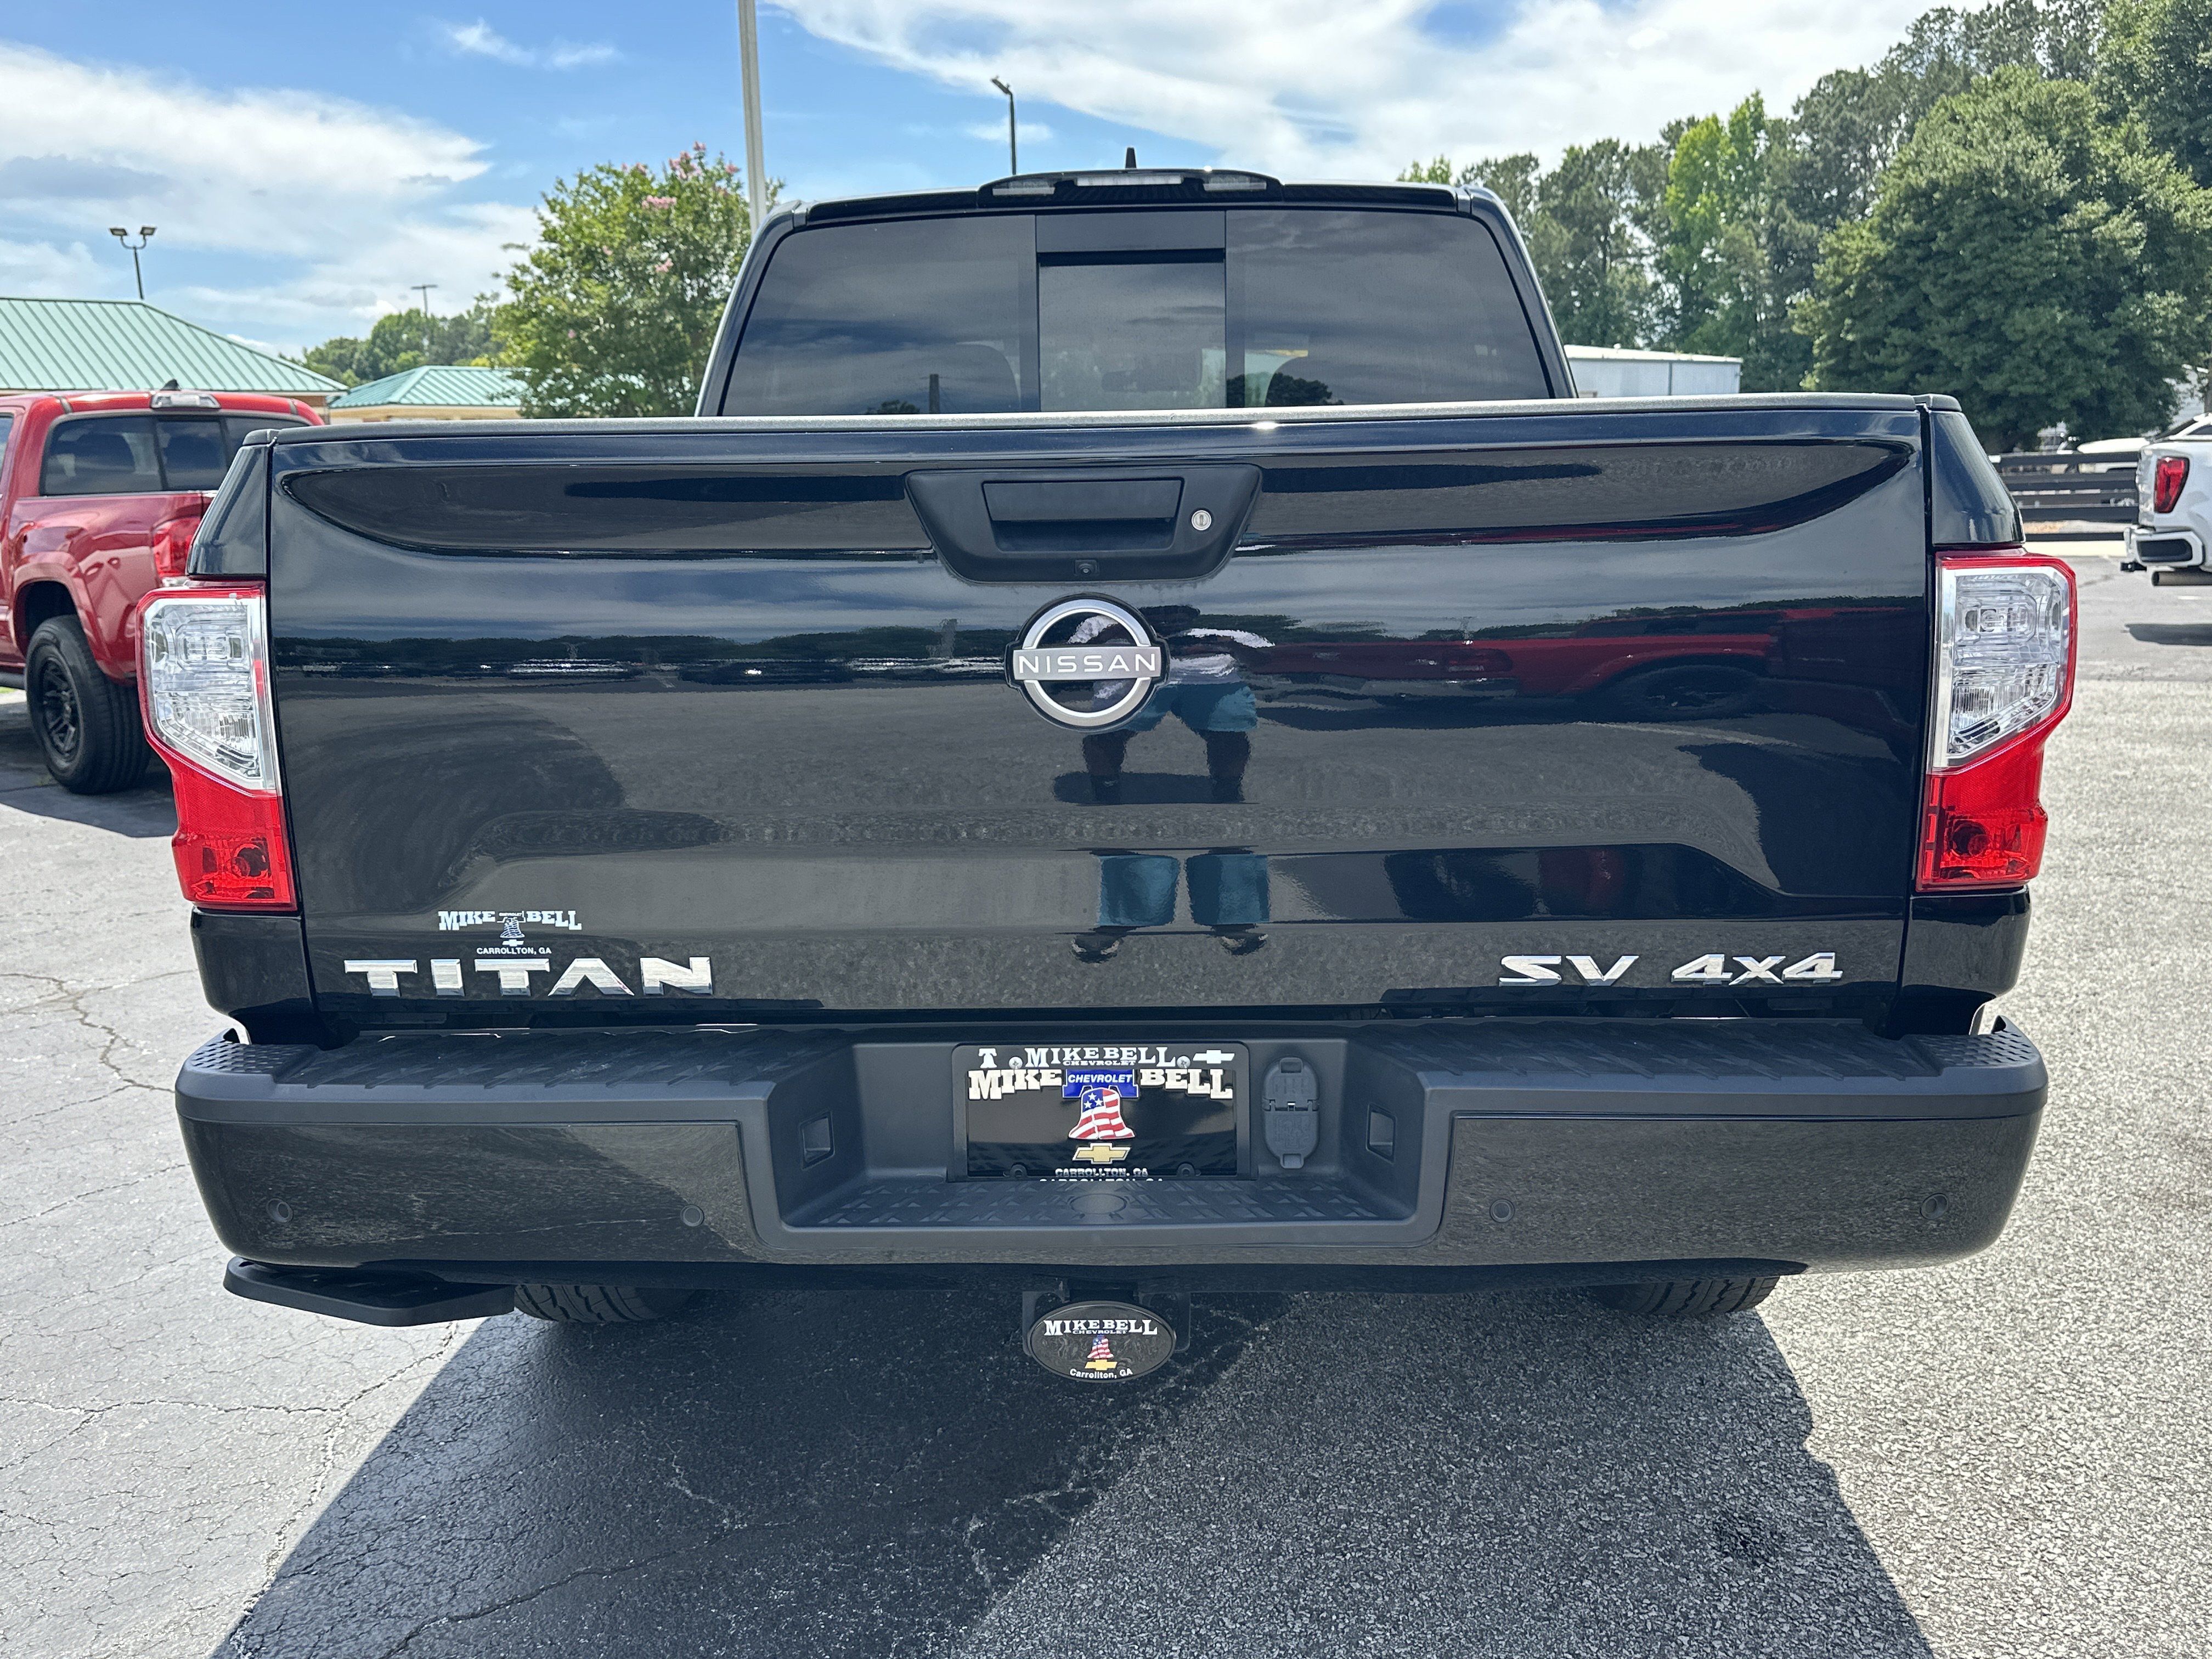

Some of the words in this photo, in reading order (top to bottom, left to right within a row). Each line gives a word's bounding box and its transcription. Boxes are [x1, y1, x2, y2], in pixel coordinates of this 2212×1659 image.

[1019, 653, 1156, 674] NISSAN
[437, 910, 496, 931] MIKE
[526, 910, 583, 930] BELL
[476, 947, 537, 955] CARROLLTON,
[344, 956, 713, 997] TITAN
[1498, 955, 1639, 987] SV
[1024, 1047, 1099, 1068] MIKE
[1103, 1046, 1176, 1067] BELL
[968, 1069, 1062, 1100] MIKE
[1139, 1069, 1233, 1099] BELL
[1068, 1074, 1133, 1084] CHEVROLET
[1043, 1319, 1101, 1336] MIKE
[1102, 1319, 1158, 1335] BELL
[1069, 1368, 1117, 1379] Carrollton,
[1119, 1368, 1133, 1376] GA
